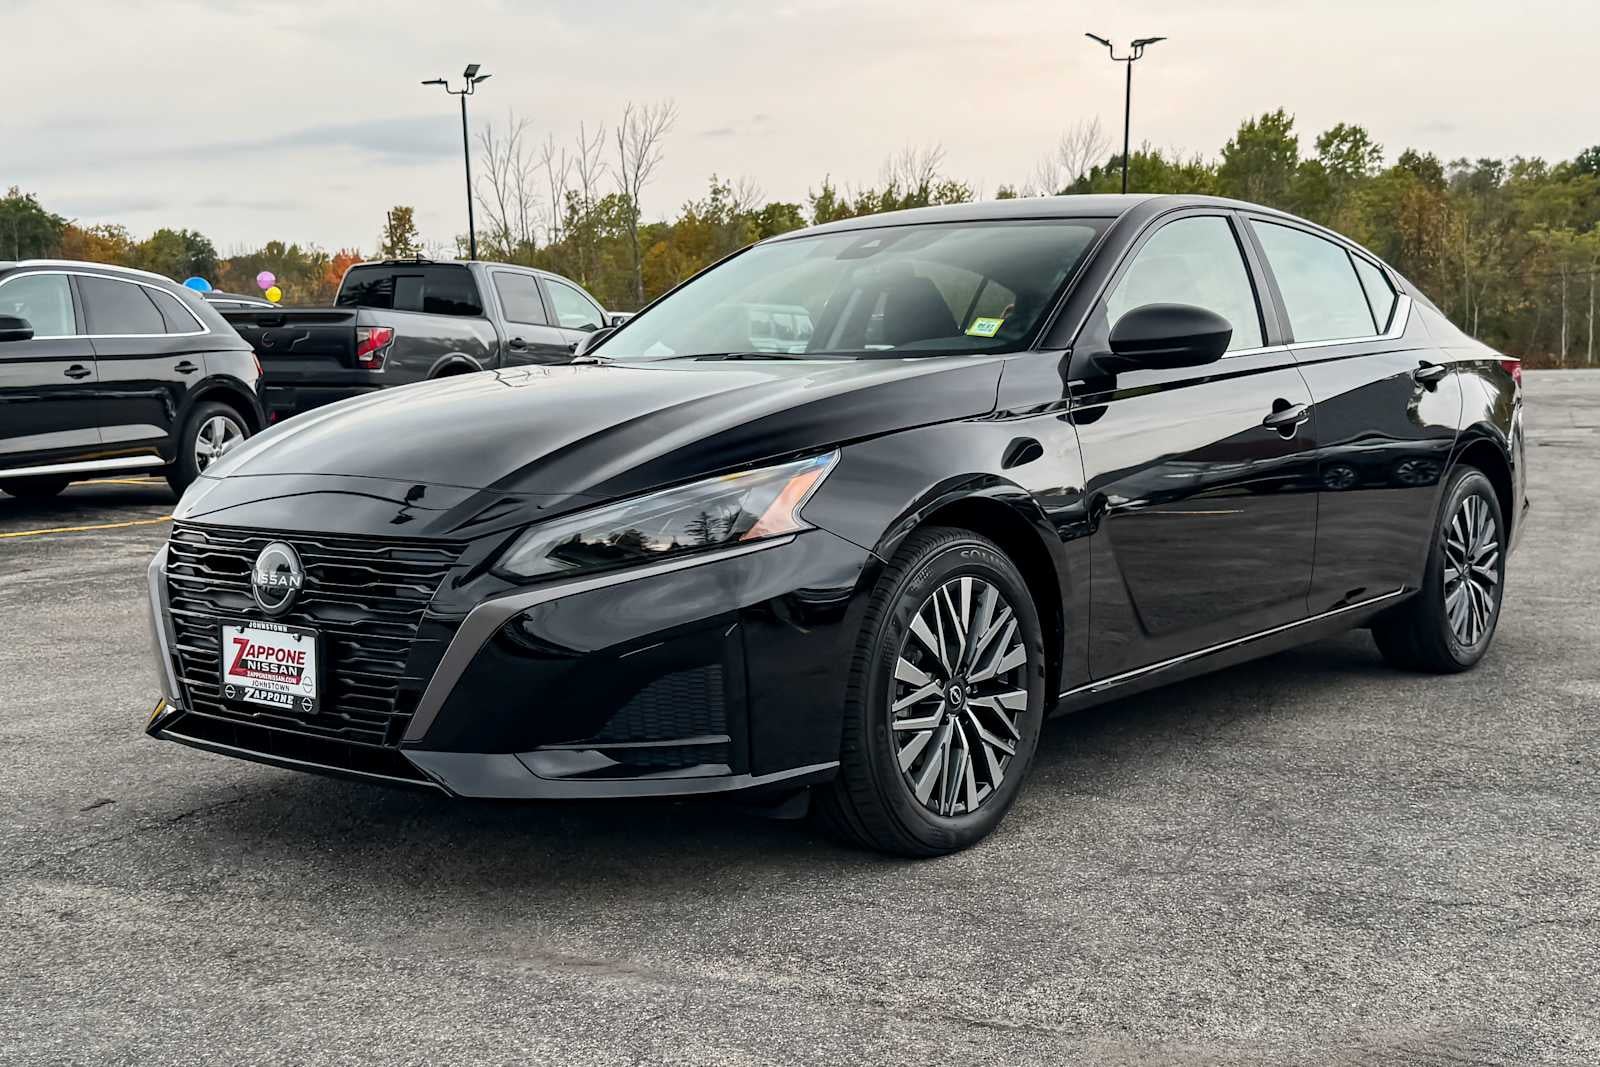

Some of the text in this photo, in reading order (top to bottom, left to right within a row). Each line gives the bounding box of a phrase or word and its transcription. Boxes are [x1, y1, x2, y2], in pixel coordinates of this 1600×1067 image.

[251, 570, 301, 587] NISSAN
[248, 621, 288, 632] JOHNSTOWN
[228, 637, 306, 676] ZAPPONE
[247, 660, 298, 676] NISSAN
[251, 680, 290, 692] JOHNSTOWN
[243, 687, 295, 706] ZAPPONE
